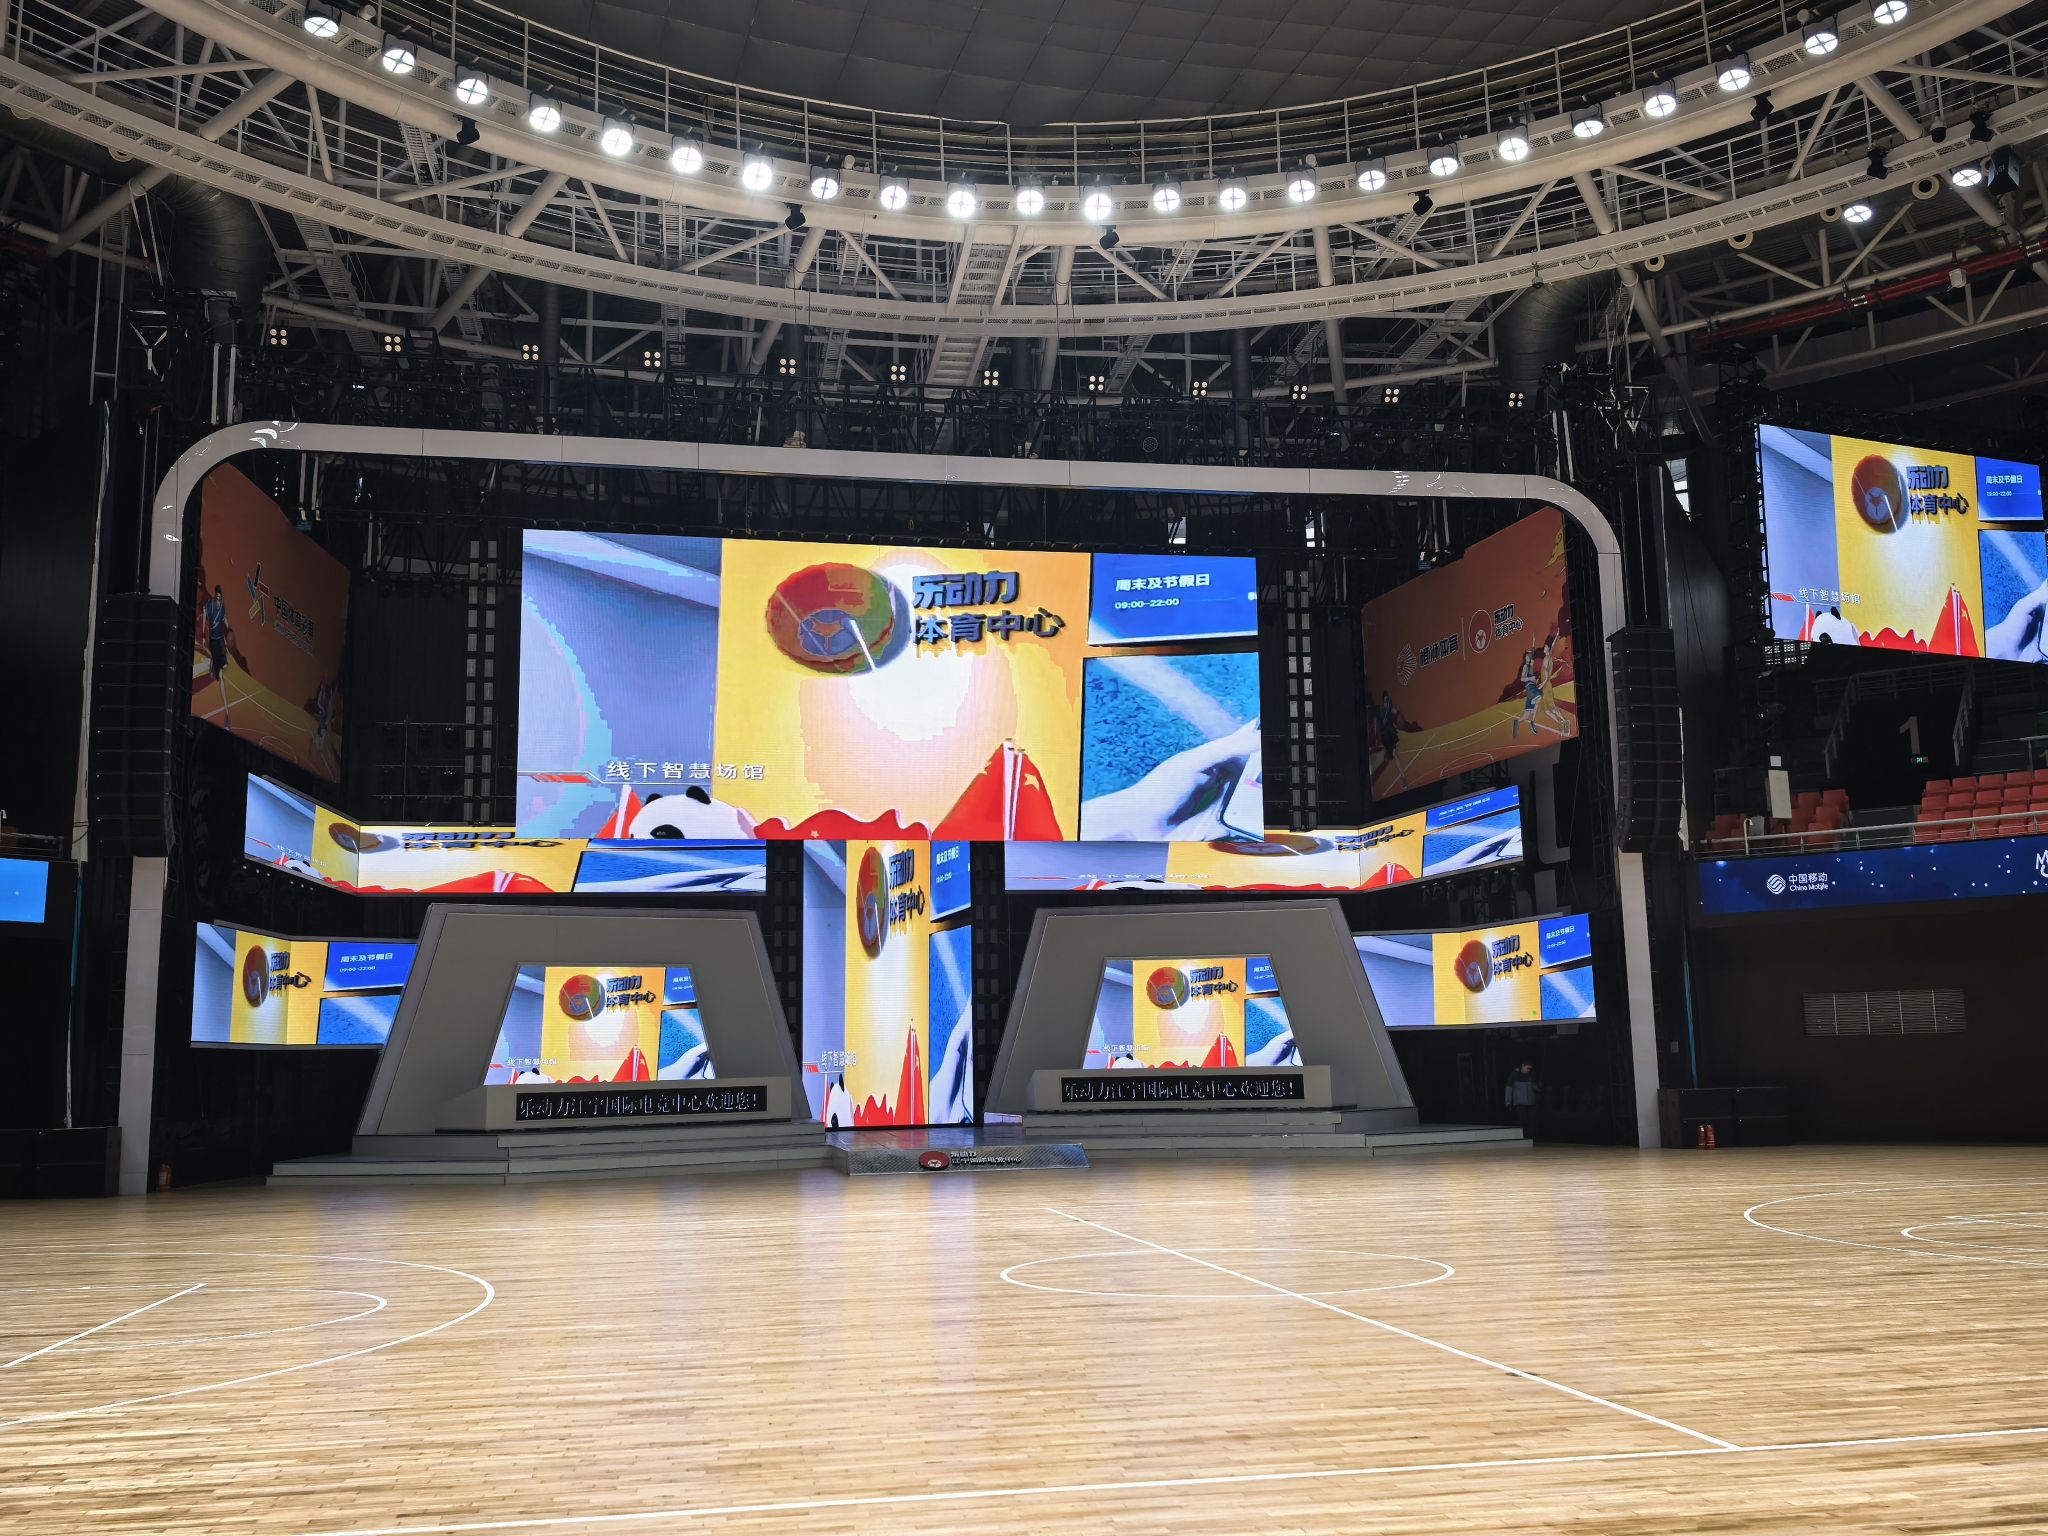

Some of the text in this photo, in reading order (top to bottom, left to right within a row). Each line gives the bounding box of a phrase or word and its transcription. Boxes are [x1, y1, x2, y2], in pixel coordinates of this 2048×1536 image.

[1906, 465, 1949, 489] 乐动力
[1909, 492, 1969, 515] 体育中心
[912, 570, 1020, 609] 乐动力
[1115, 573, 1210, 592] 周末及节假日
[1114, 597, 1180, 610] 09:00-22:00
[912, 607, 1067, 646] 体育中心
[1899, 716, 1920, 755] 1
[607, 760, 765, 781] 线下智慧场馆
[1788, 872, 1828, 884] 中国移动
[1808, 882, 1829, 891] Mobile
[1493, 952, 1534, 976] 体育中心
[606, 990, 657, 1007] 体育中心
[1190, 980, 1239, 997] 体育中心
